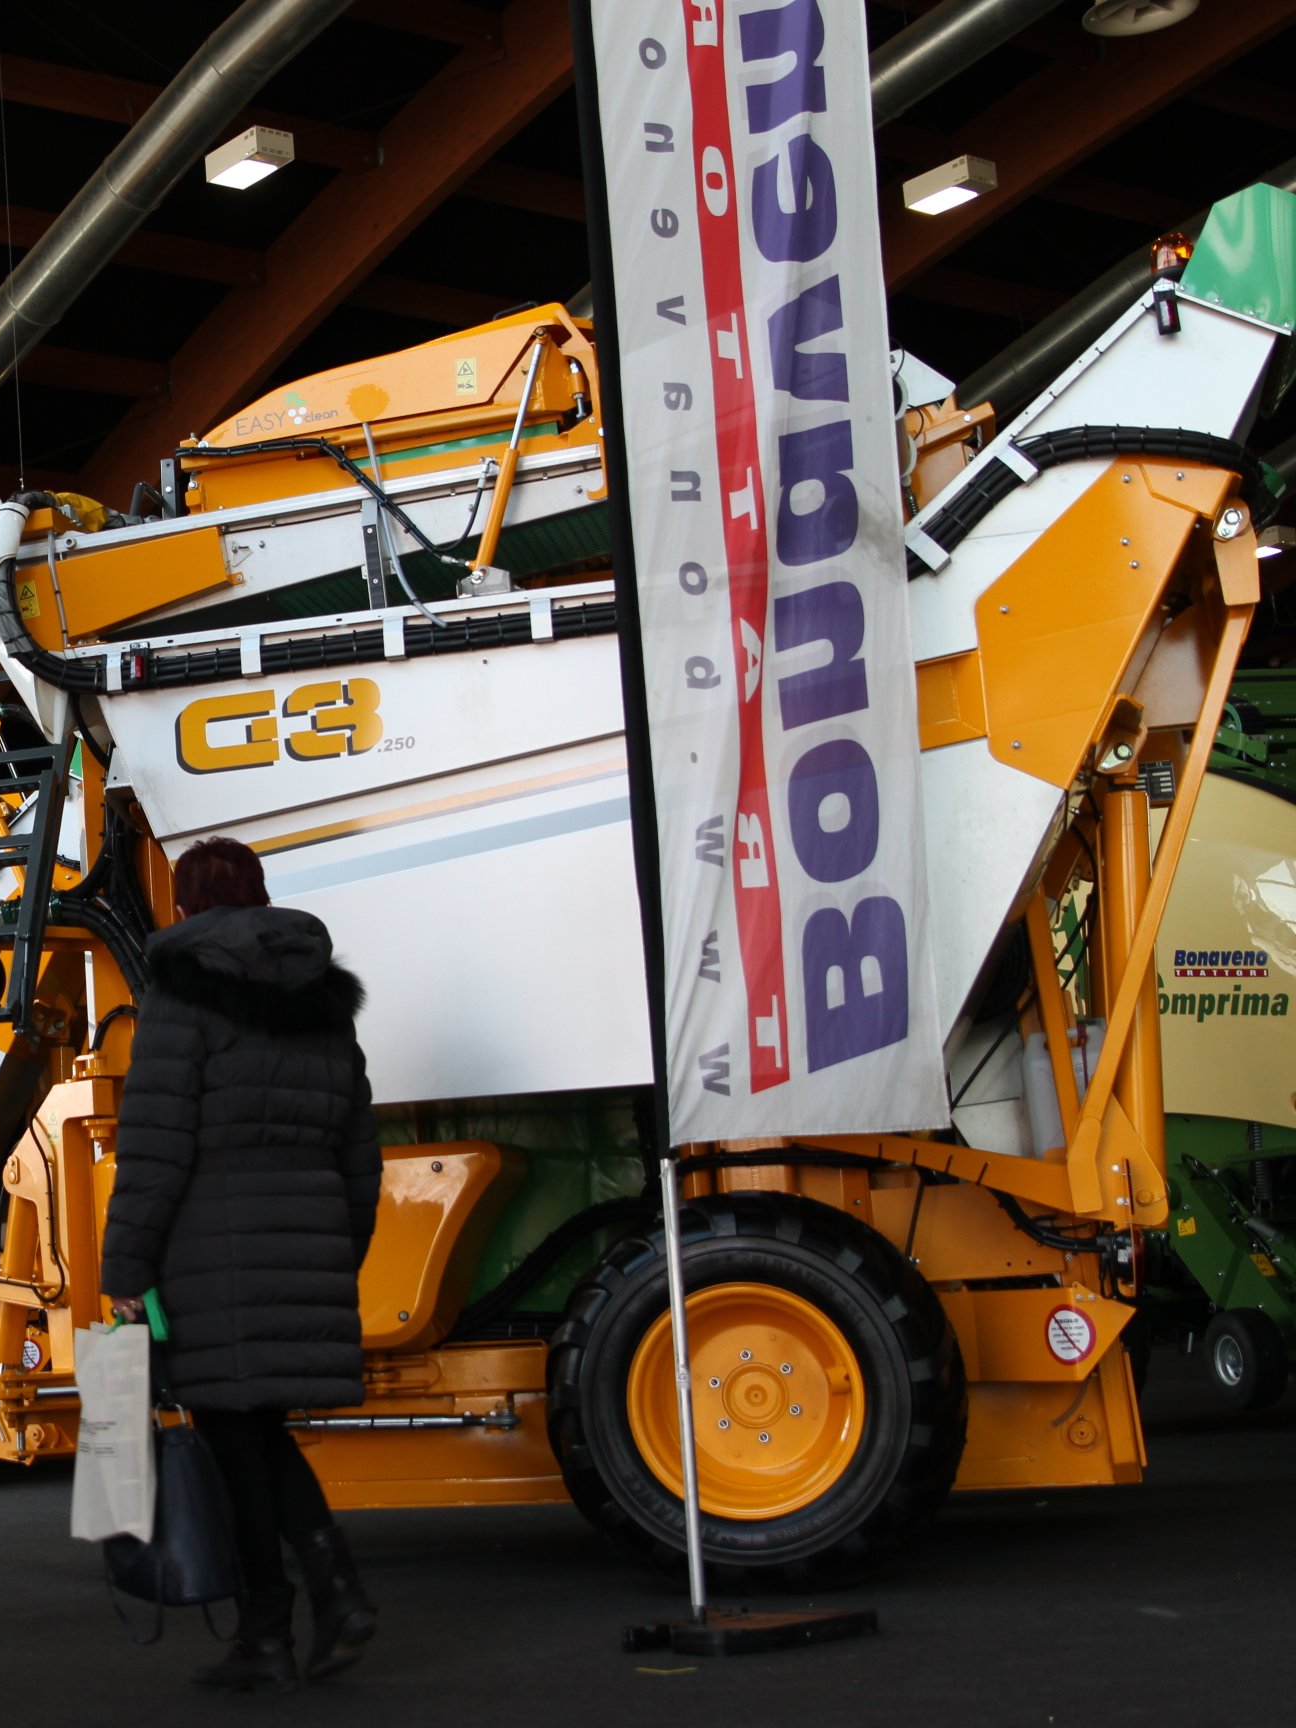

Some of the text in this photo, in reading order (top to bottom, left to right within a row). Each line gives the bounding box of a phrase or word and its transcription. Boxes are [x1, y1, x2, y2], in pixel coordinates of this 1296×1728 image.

[236, 409, 338, 436] EASY clean
[175, 678, 383, 775] G3
[1174, 950, 1268, 966] Bonaveno
[1158, 973, 1289, 1023] omprima
